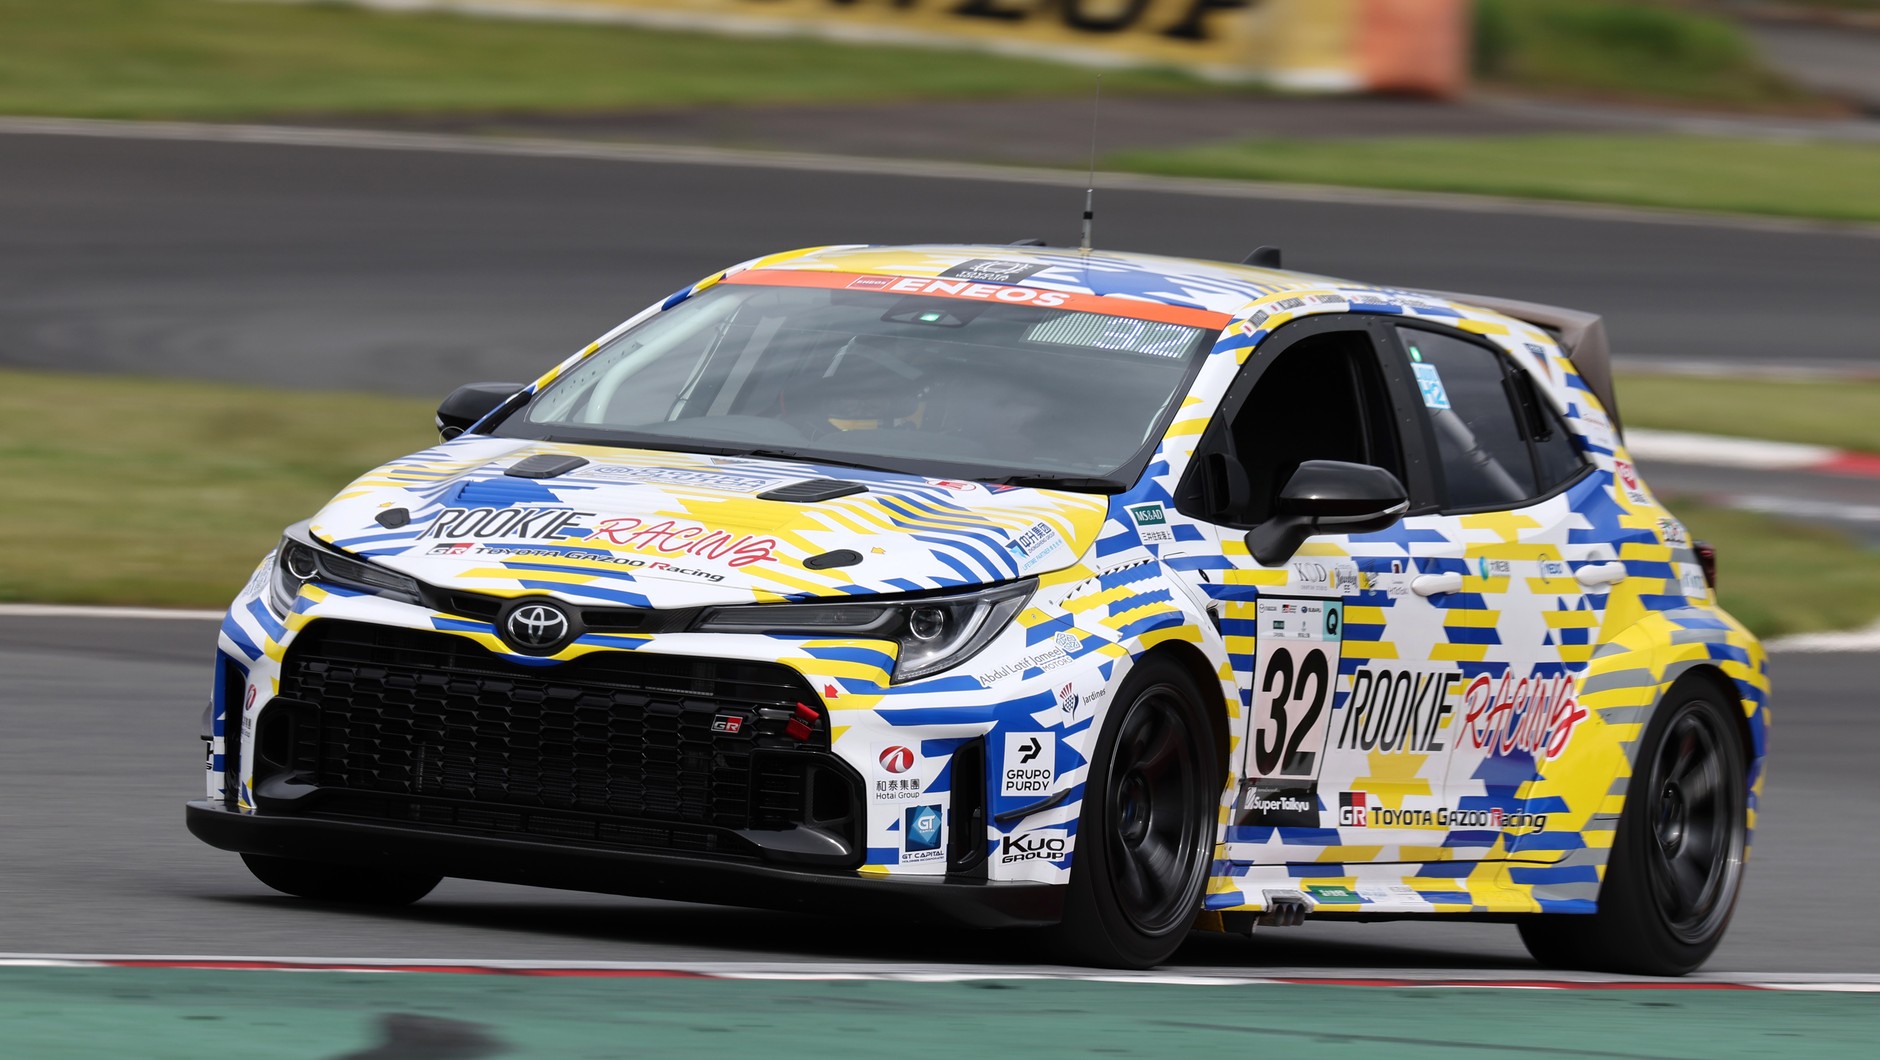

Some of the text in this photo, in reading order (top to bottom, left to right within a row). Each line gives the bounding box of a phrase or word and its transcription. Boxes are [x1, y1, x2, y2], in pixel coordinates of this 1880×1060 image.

[856, 279, 887, 287] ENEOS
[889, 278, 1071, 307] ENEOS
[1135, 509, 1163, 522] MS&AD
[417, 508, 778, 568] ROOKIE RACING
[427, 545, 726, 583] GR TOYOTA GAZOO Racing
[1326, 608, 1338, 635] Q
[979, 645, 1064, 686] Abdul Latif Jameel
[1042, 656, 1073, 672] MOTORS
[1082, 688, 1107, 706] Jardines
[1255, 646, 1329, 776] 32
[1337, 668, 1587, 758] ROOKIE RACING
[713, 720, 740, 732] GR
[1006, 769, 1051, 780] GRUPO
[876, 778, 920, 791] 和泰集團
[1006, 781, 1050, 792] PURDY
[876, 791, 920, 801] Hotai Group
[917, 815, 937, 831] GT
[1339, 804, 1547, 834] GR TOYOTA GAZOO Racing
[914, 850, 944, 859] CAPITAL
[1002, 852, 1064, 864] GROUP
